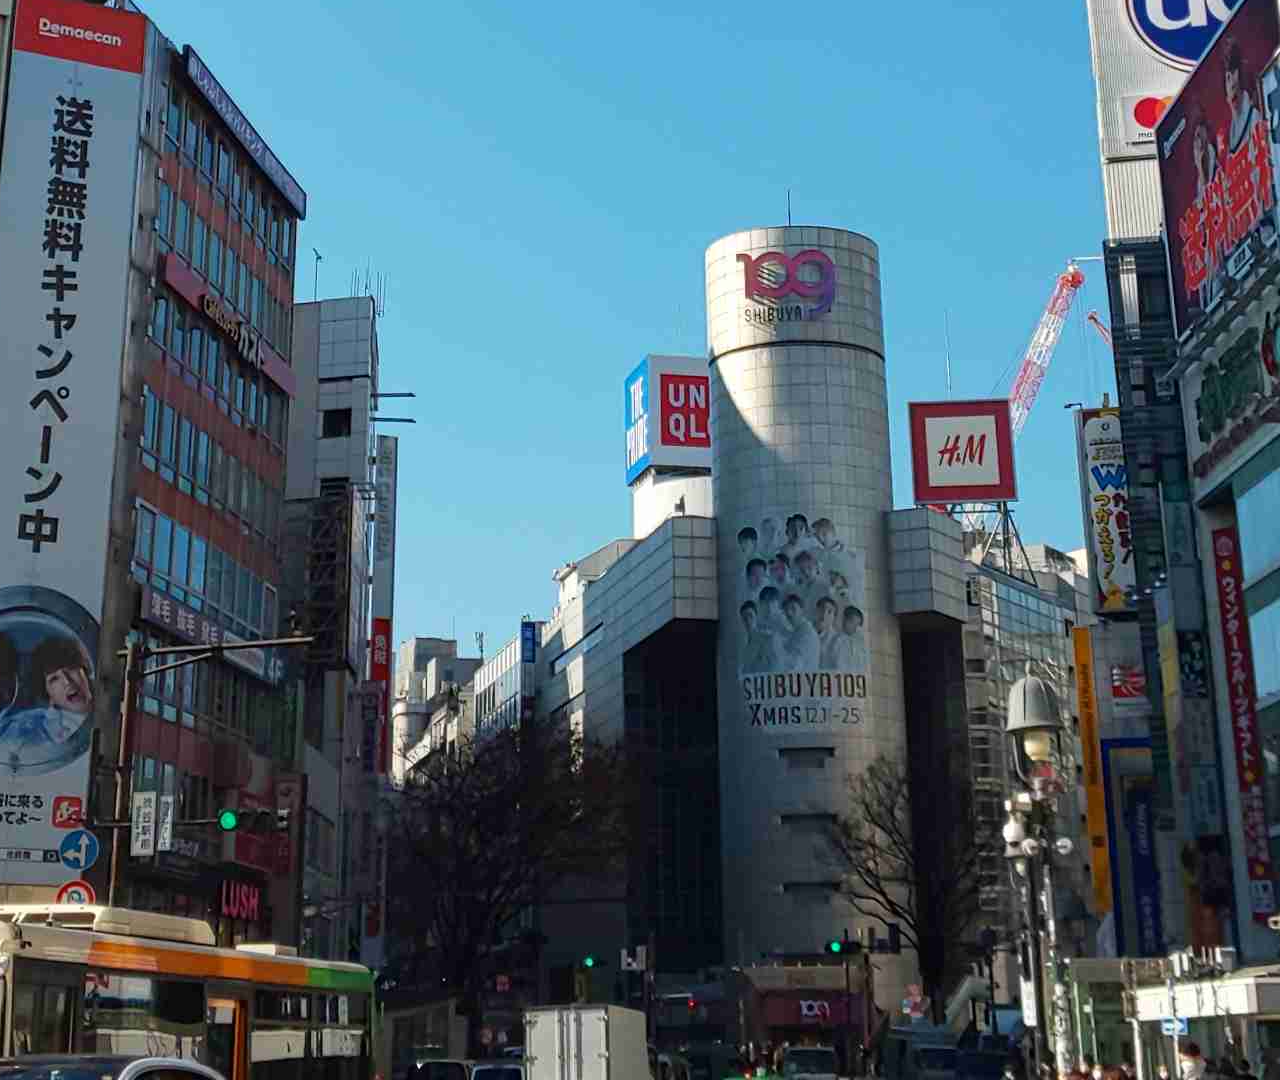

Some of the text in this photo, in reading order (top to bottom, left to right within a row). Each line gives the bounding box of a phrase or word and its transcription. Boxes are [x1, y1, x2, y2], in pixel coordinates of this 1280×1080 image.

[39, 18, 121, 47] Demaecan
[736, 249, 833, 312] 109
[17, 96, 93, 553] 送料無料キャンペーン中
[745, 305, 802, 321] SHIBUYA
[668, 384, 706, 408] UN
[669, 413, 710, 441] QL
[939, 433, 985, 468] H&M
[744, 672, 866, 700] SHIBUYA109
[223, 880, 259, 920] LUSH
